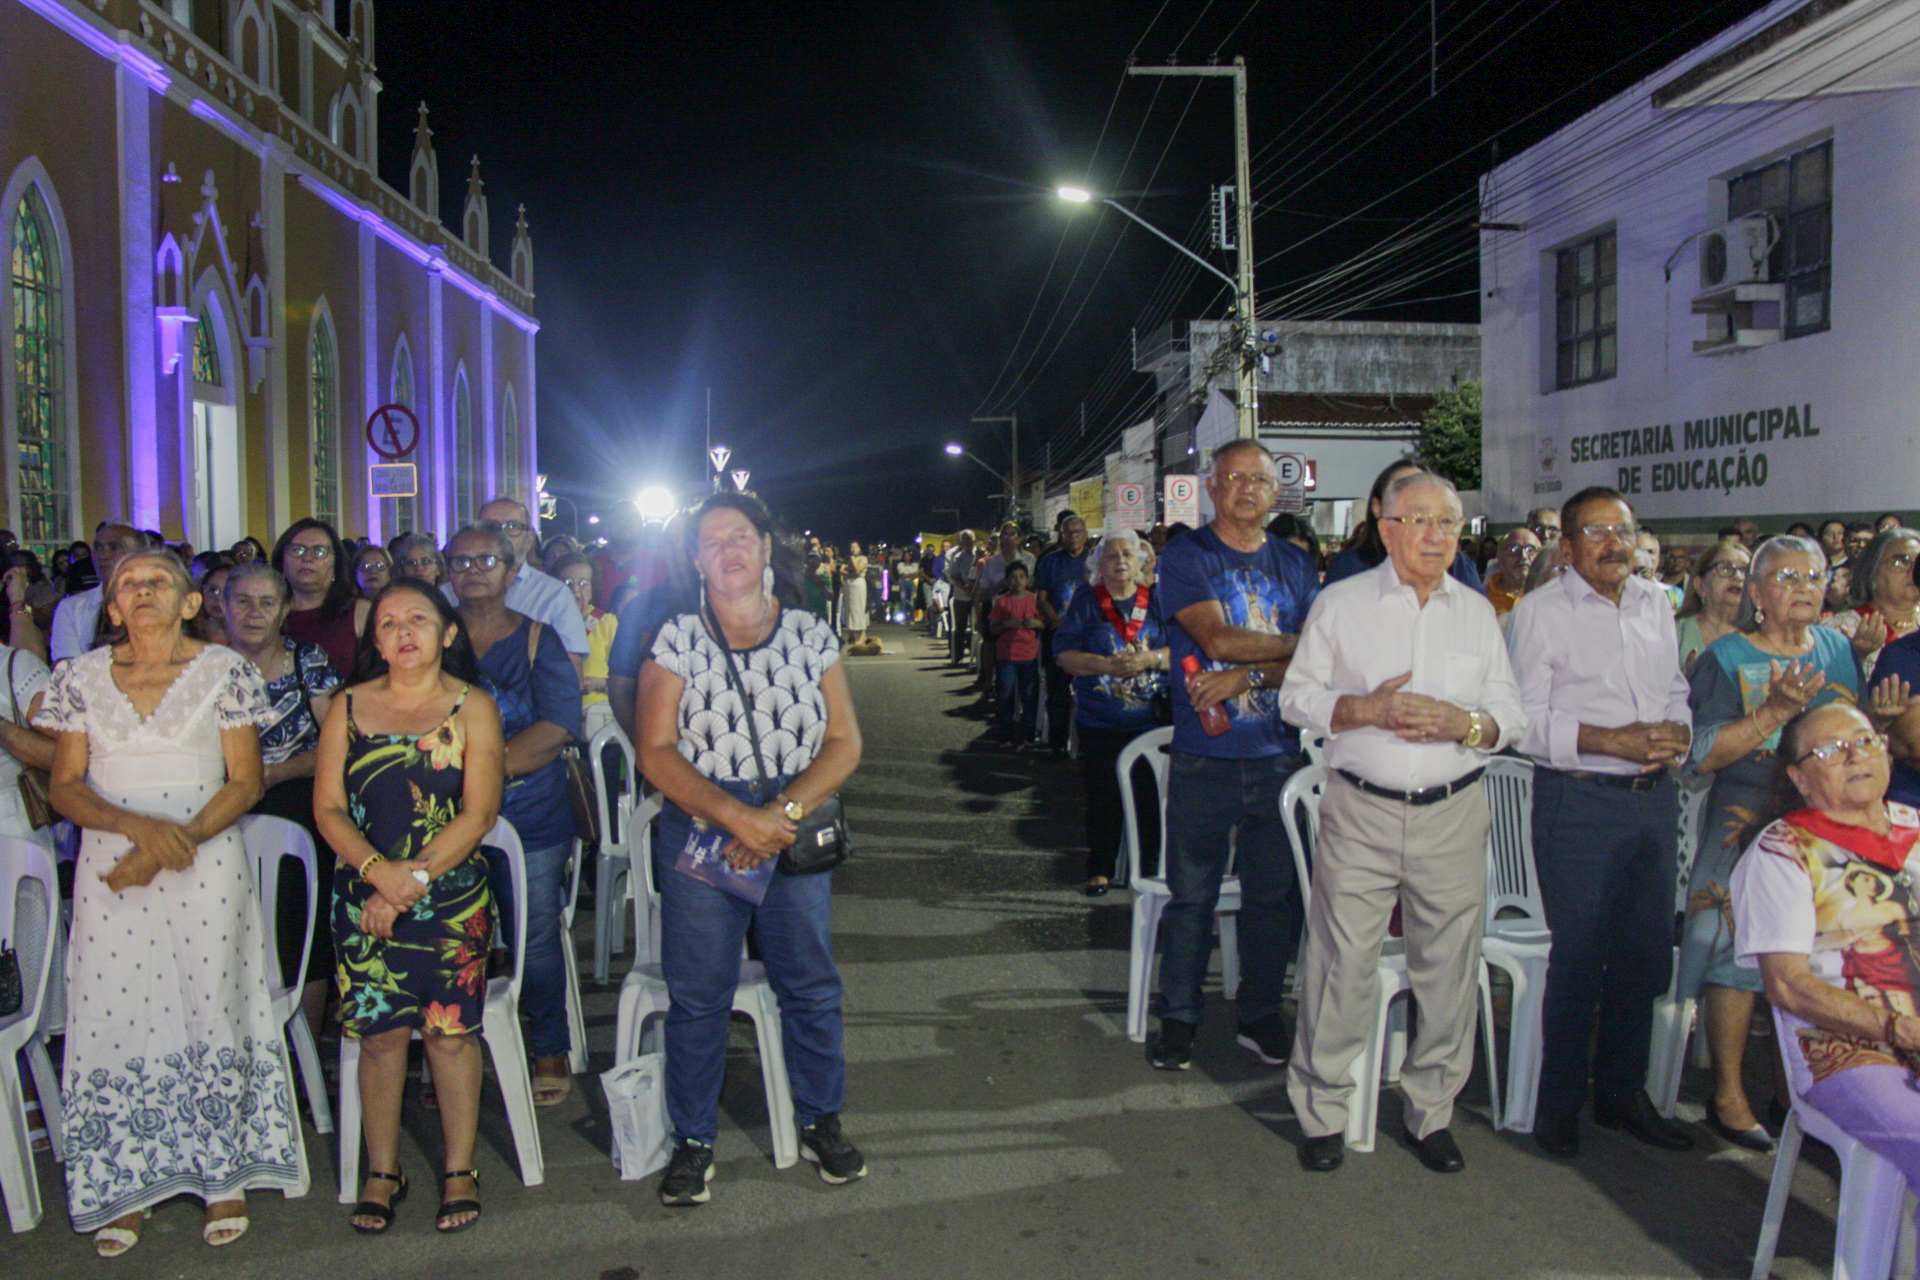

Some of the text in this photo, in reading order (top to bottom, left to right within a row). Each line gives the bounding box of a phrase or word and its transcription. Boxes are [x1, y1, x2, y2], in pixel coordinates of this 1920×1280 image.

[1571, 404, 1820, 463] SECRETARIA MUNICIPAL
[1282, 463, 1292, 478] E
[1618, 449, 1768, 496] DE EDUCAÇÃO
[1127, 490, 1134, 501] E
[1178, 485, 1186, 497] E
